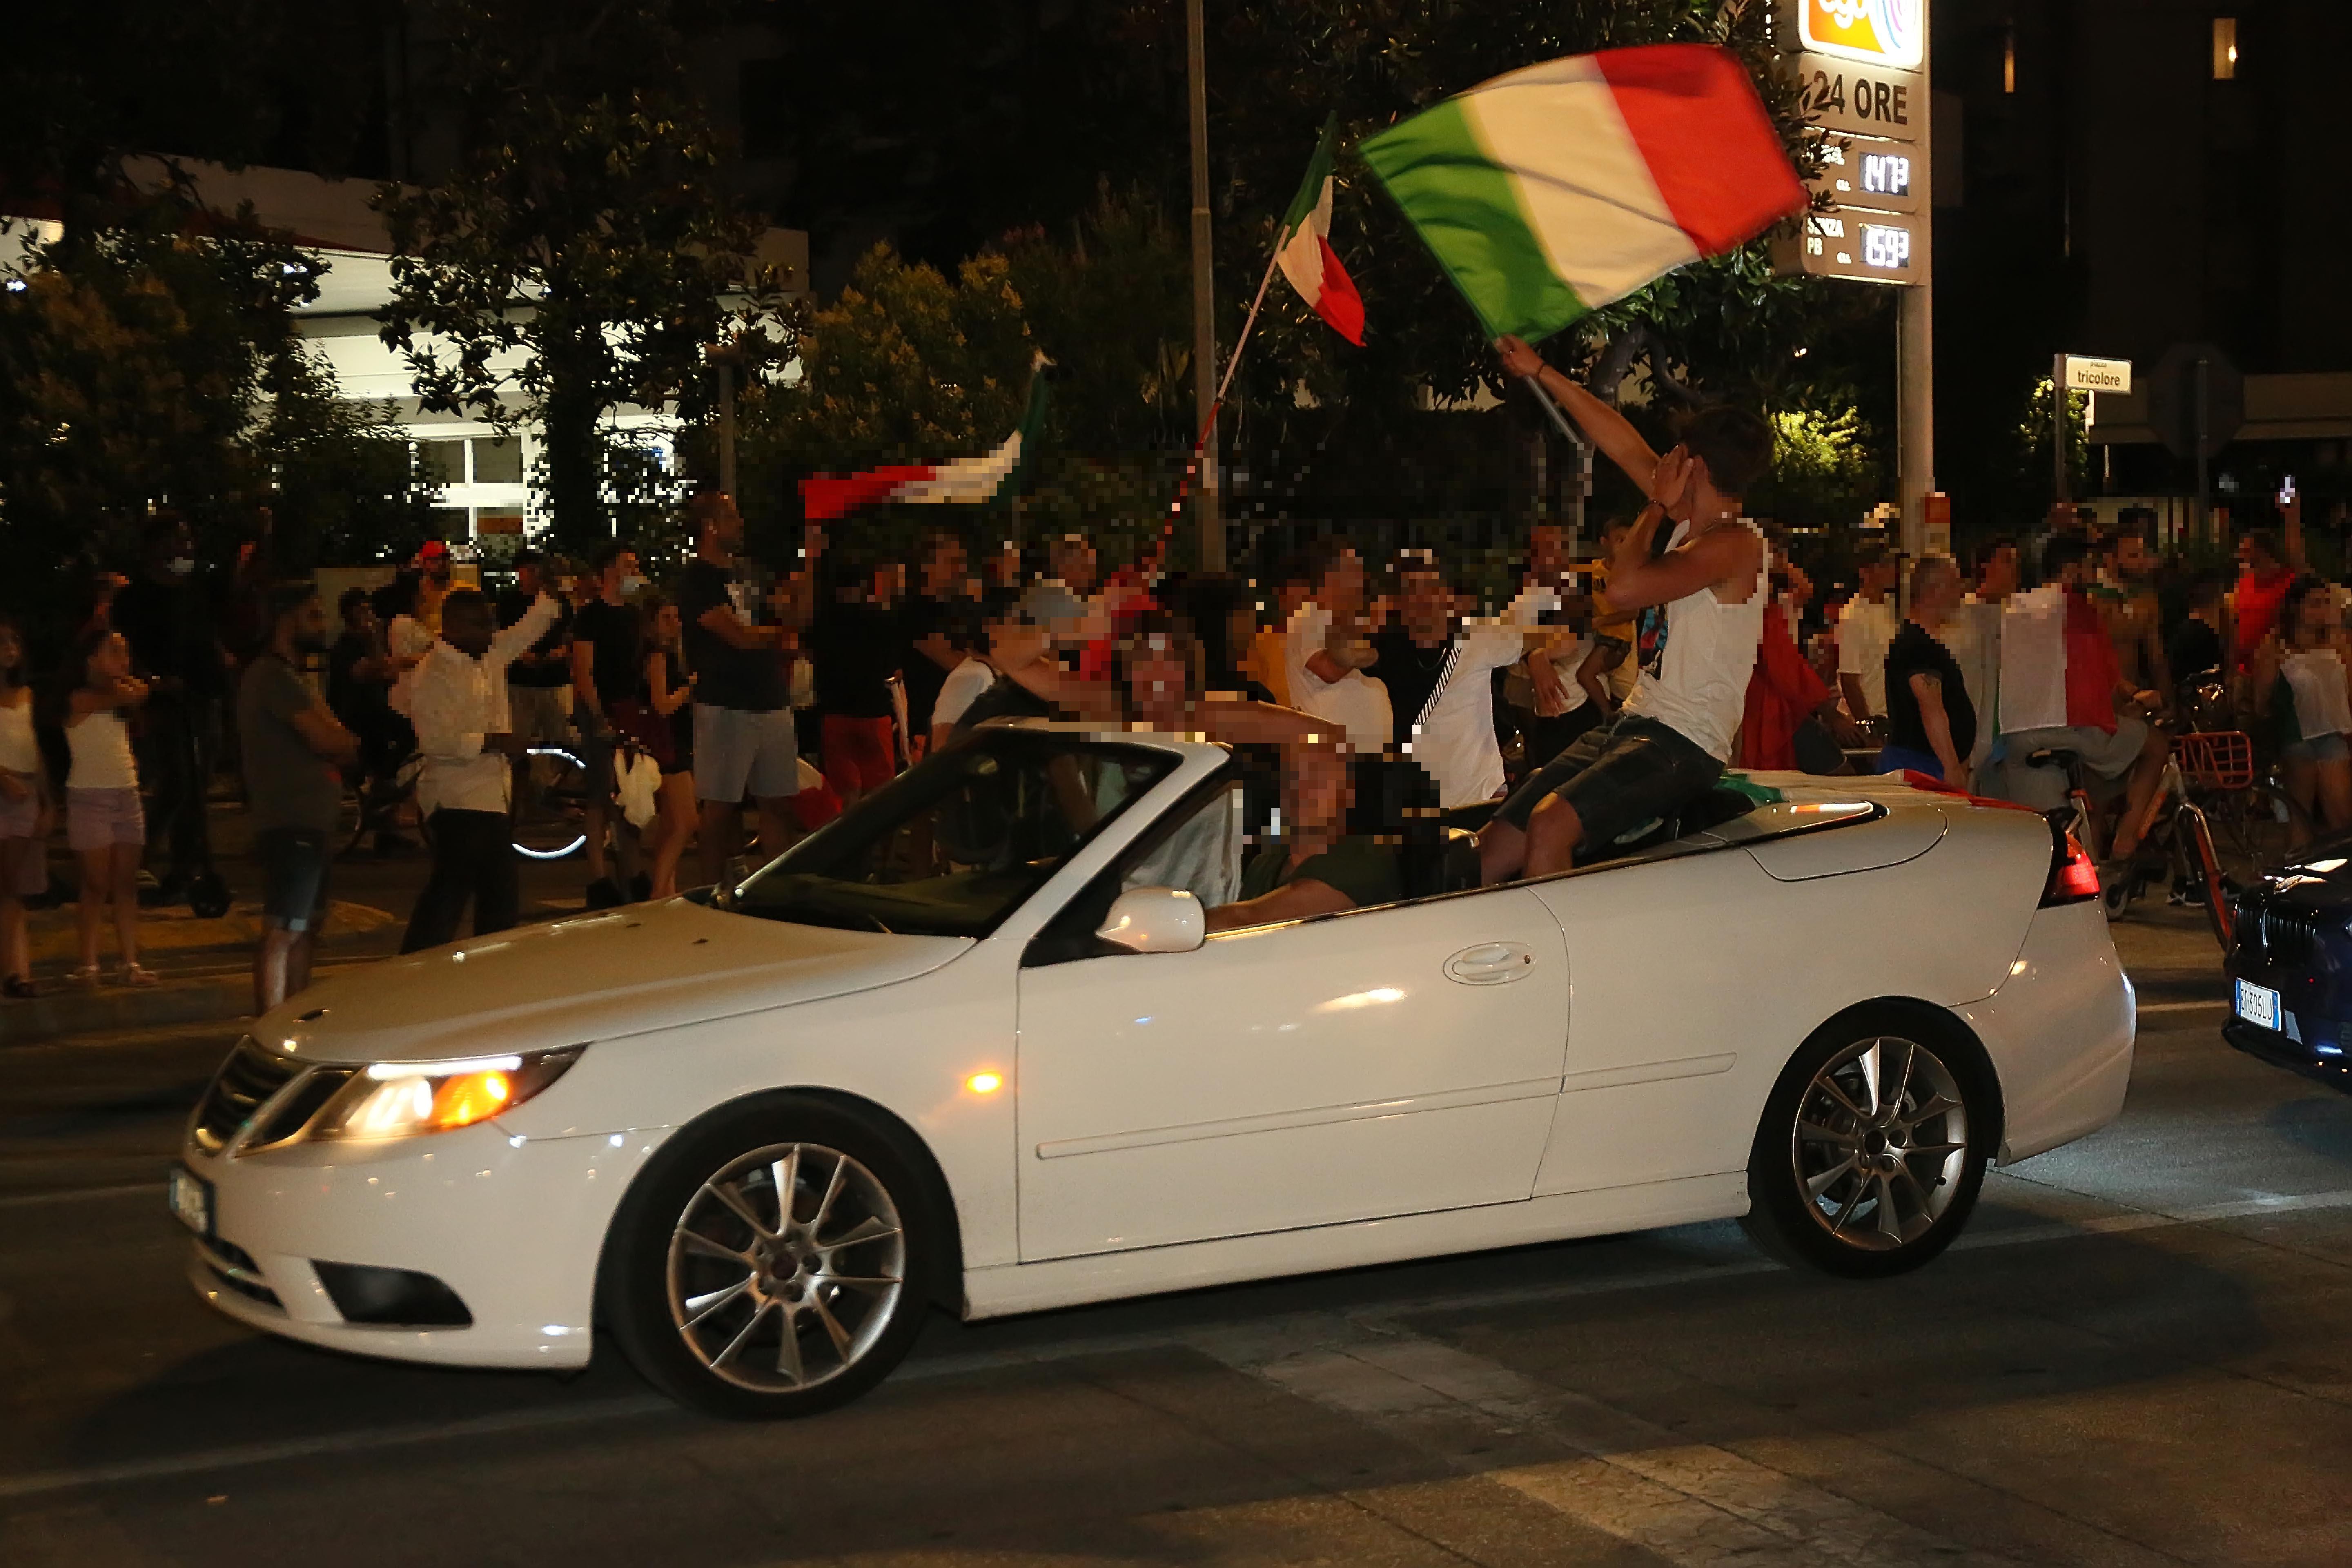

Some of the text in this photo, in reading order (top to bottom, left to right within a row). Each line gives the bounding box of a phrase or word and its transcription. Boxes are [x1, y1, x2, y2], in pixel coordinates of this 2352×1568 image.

[1855, 78, 1907, 125] ORE
[1807, 237, 1823, 255] PB
[2078, 370, 2120, 386] tricolore
